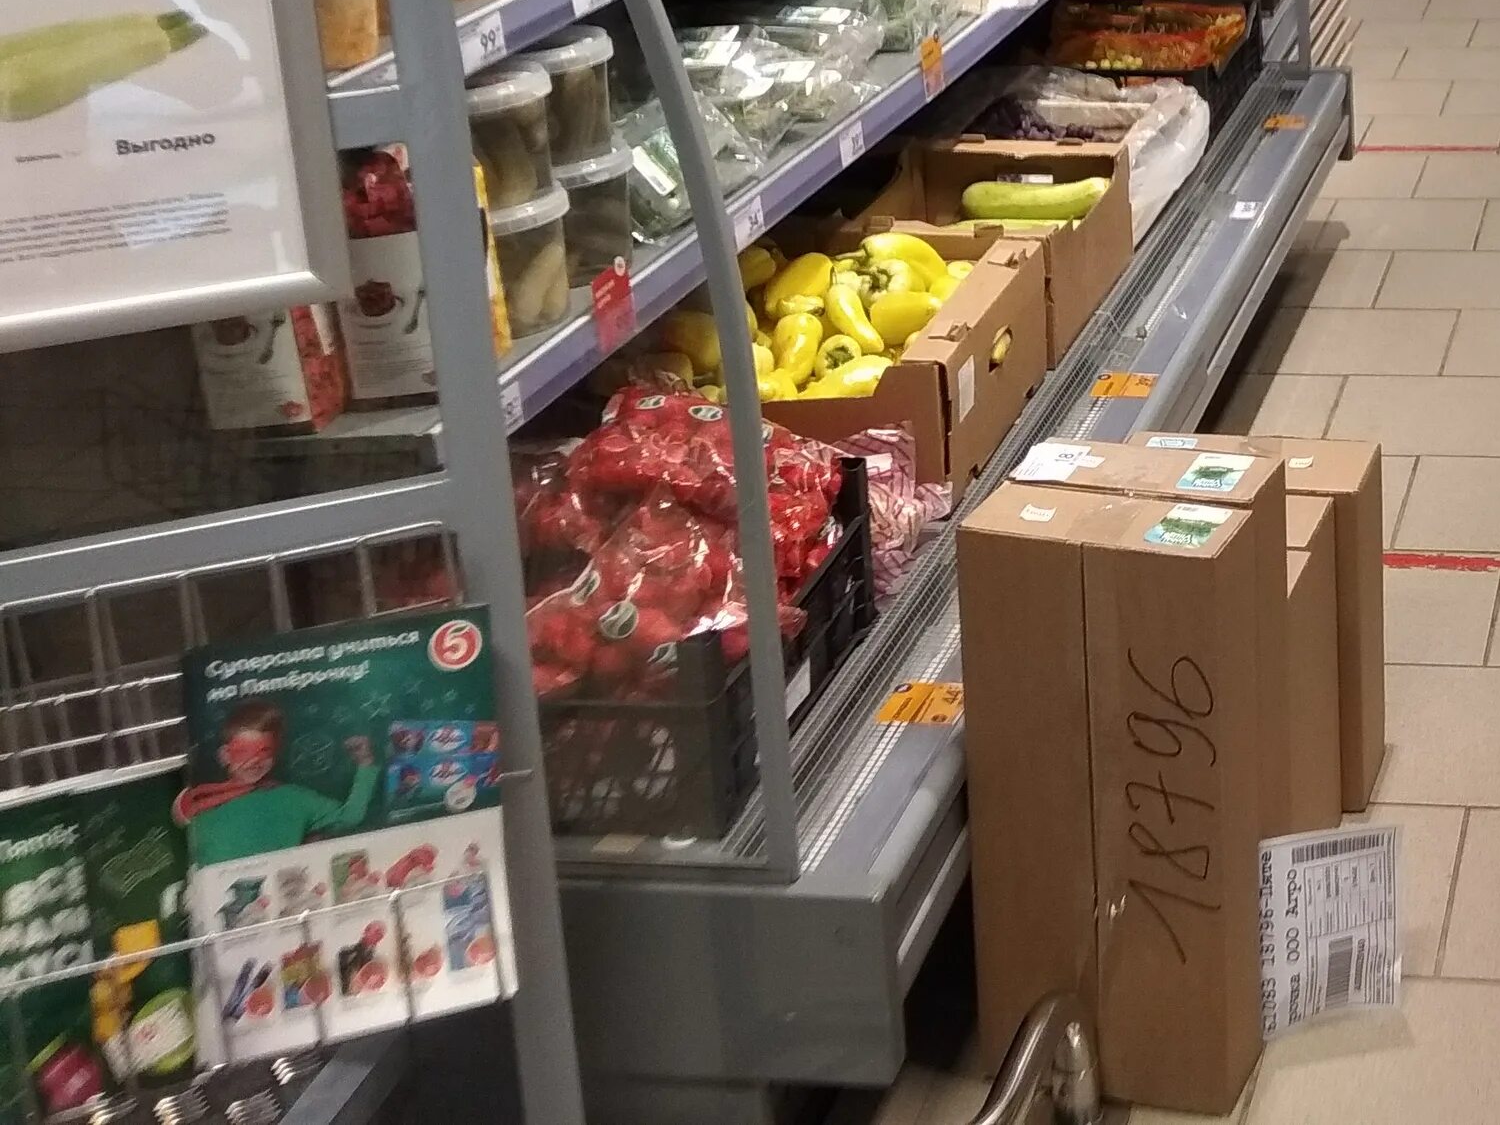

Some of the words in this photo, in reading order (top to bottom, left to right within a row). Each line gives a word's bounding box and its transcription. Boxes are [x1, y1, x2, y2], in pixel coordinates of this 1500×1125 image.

[479, 30, 496, 54] 99
[115, 131, 216, 156] Выгодно
[204, 644, 324, 679] Суперсила
[327, 629, 420, 662] учиться
[206, 685, 238, 703] на
[237, 661, 370, 697] Пятёрочку!
[1127, 648, 1222, 965] 18796
[1285, 868, 1302, 919] Агро
